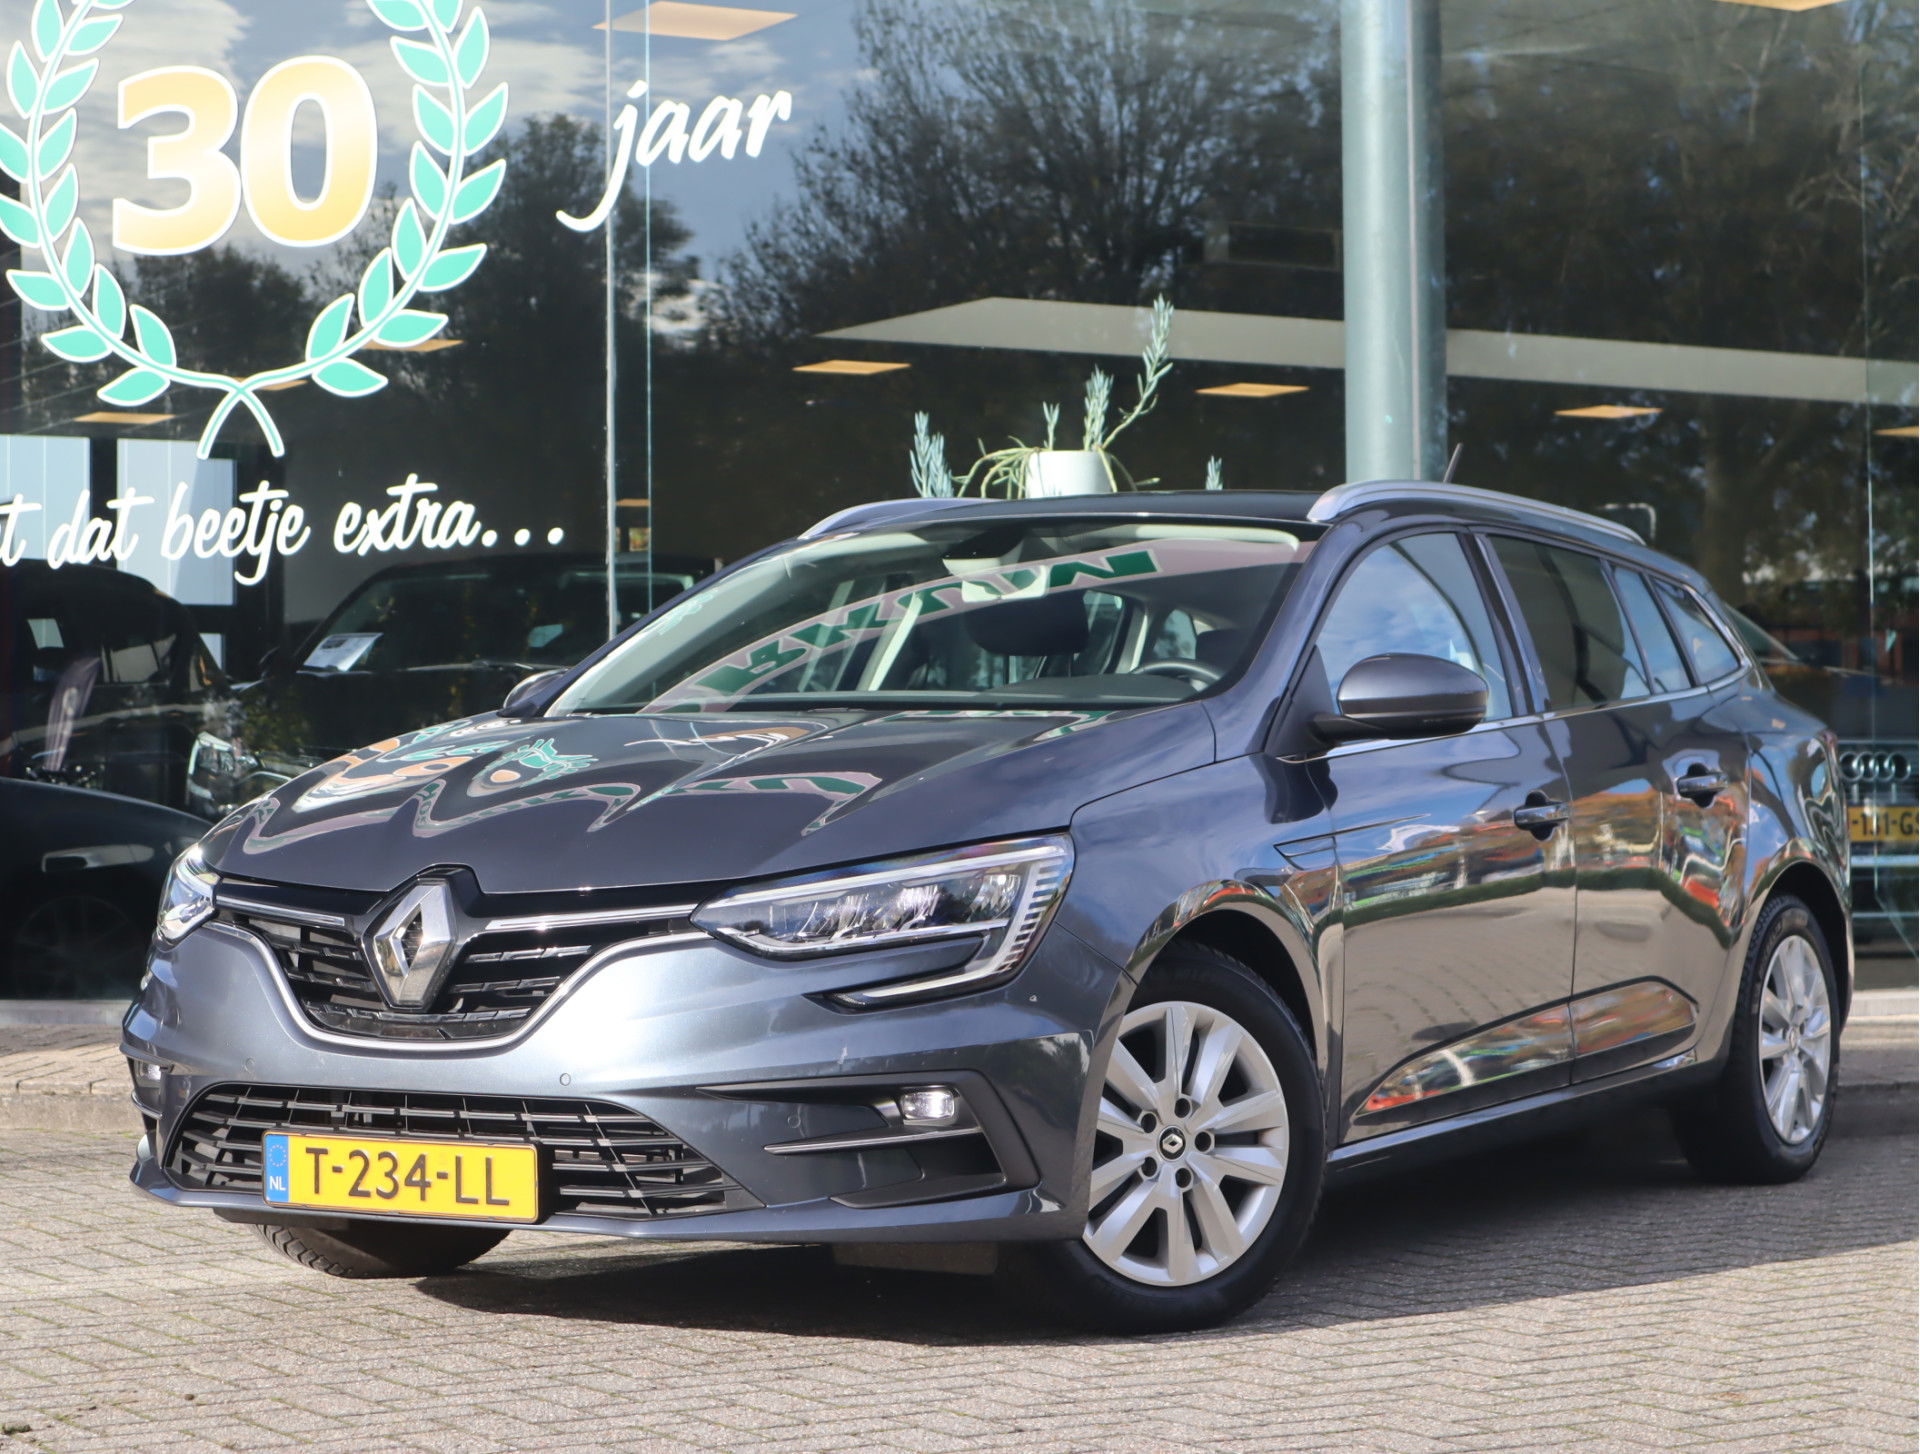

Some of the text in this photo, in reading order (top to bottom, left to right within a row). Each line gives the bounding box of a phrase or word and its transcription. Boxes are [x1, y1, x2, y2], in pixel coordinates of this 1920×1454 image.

[112, 54, 793, 256] 30 jaar
[47, 488, 155, 570] dat
[160, 480, 311, 586] beetje
[268, 1146, 510, 1206] NL T-234-LL
